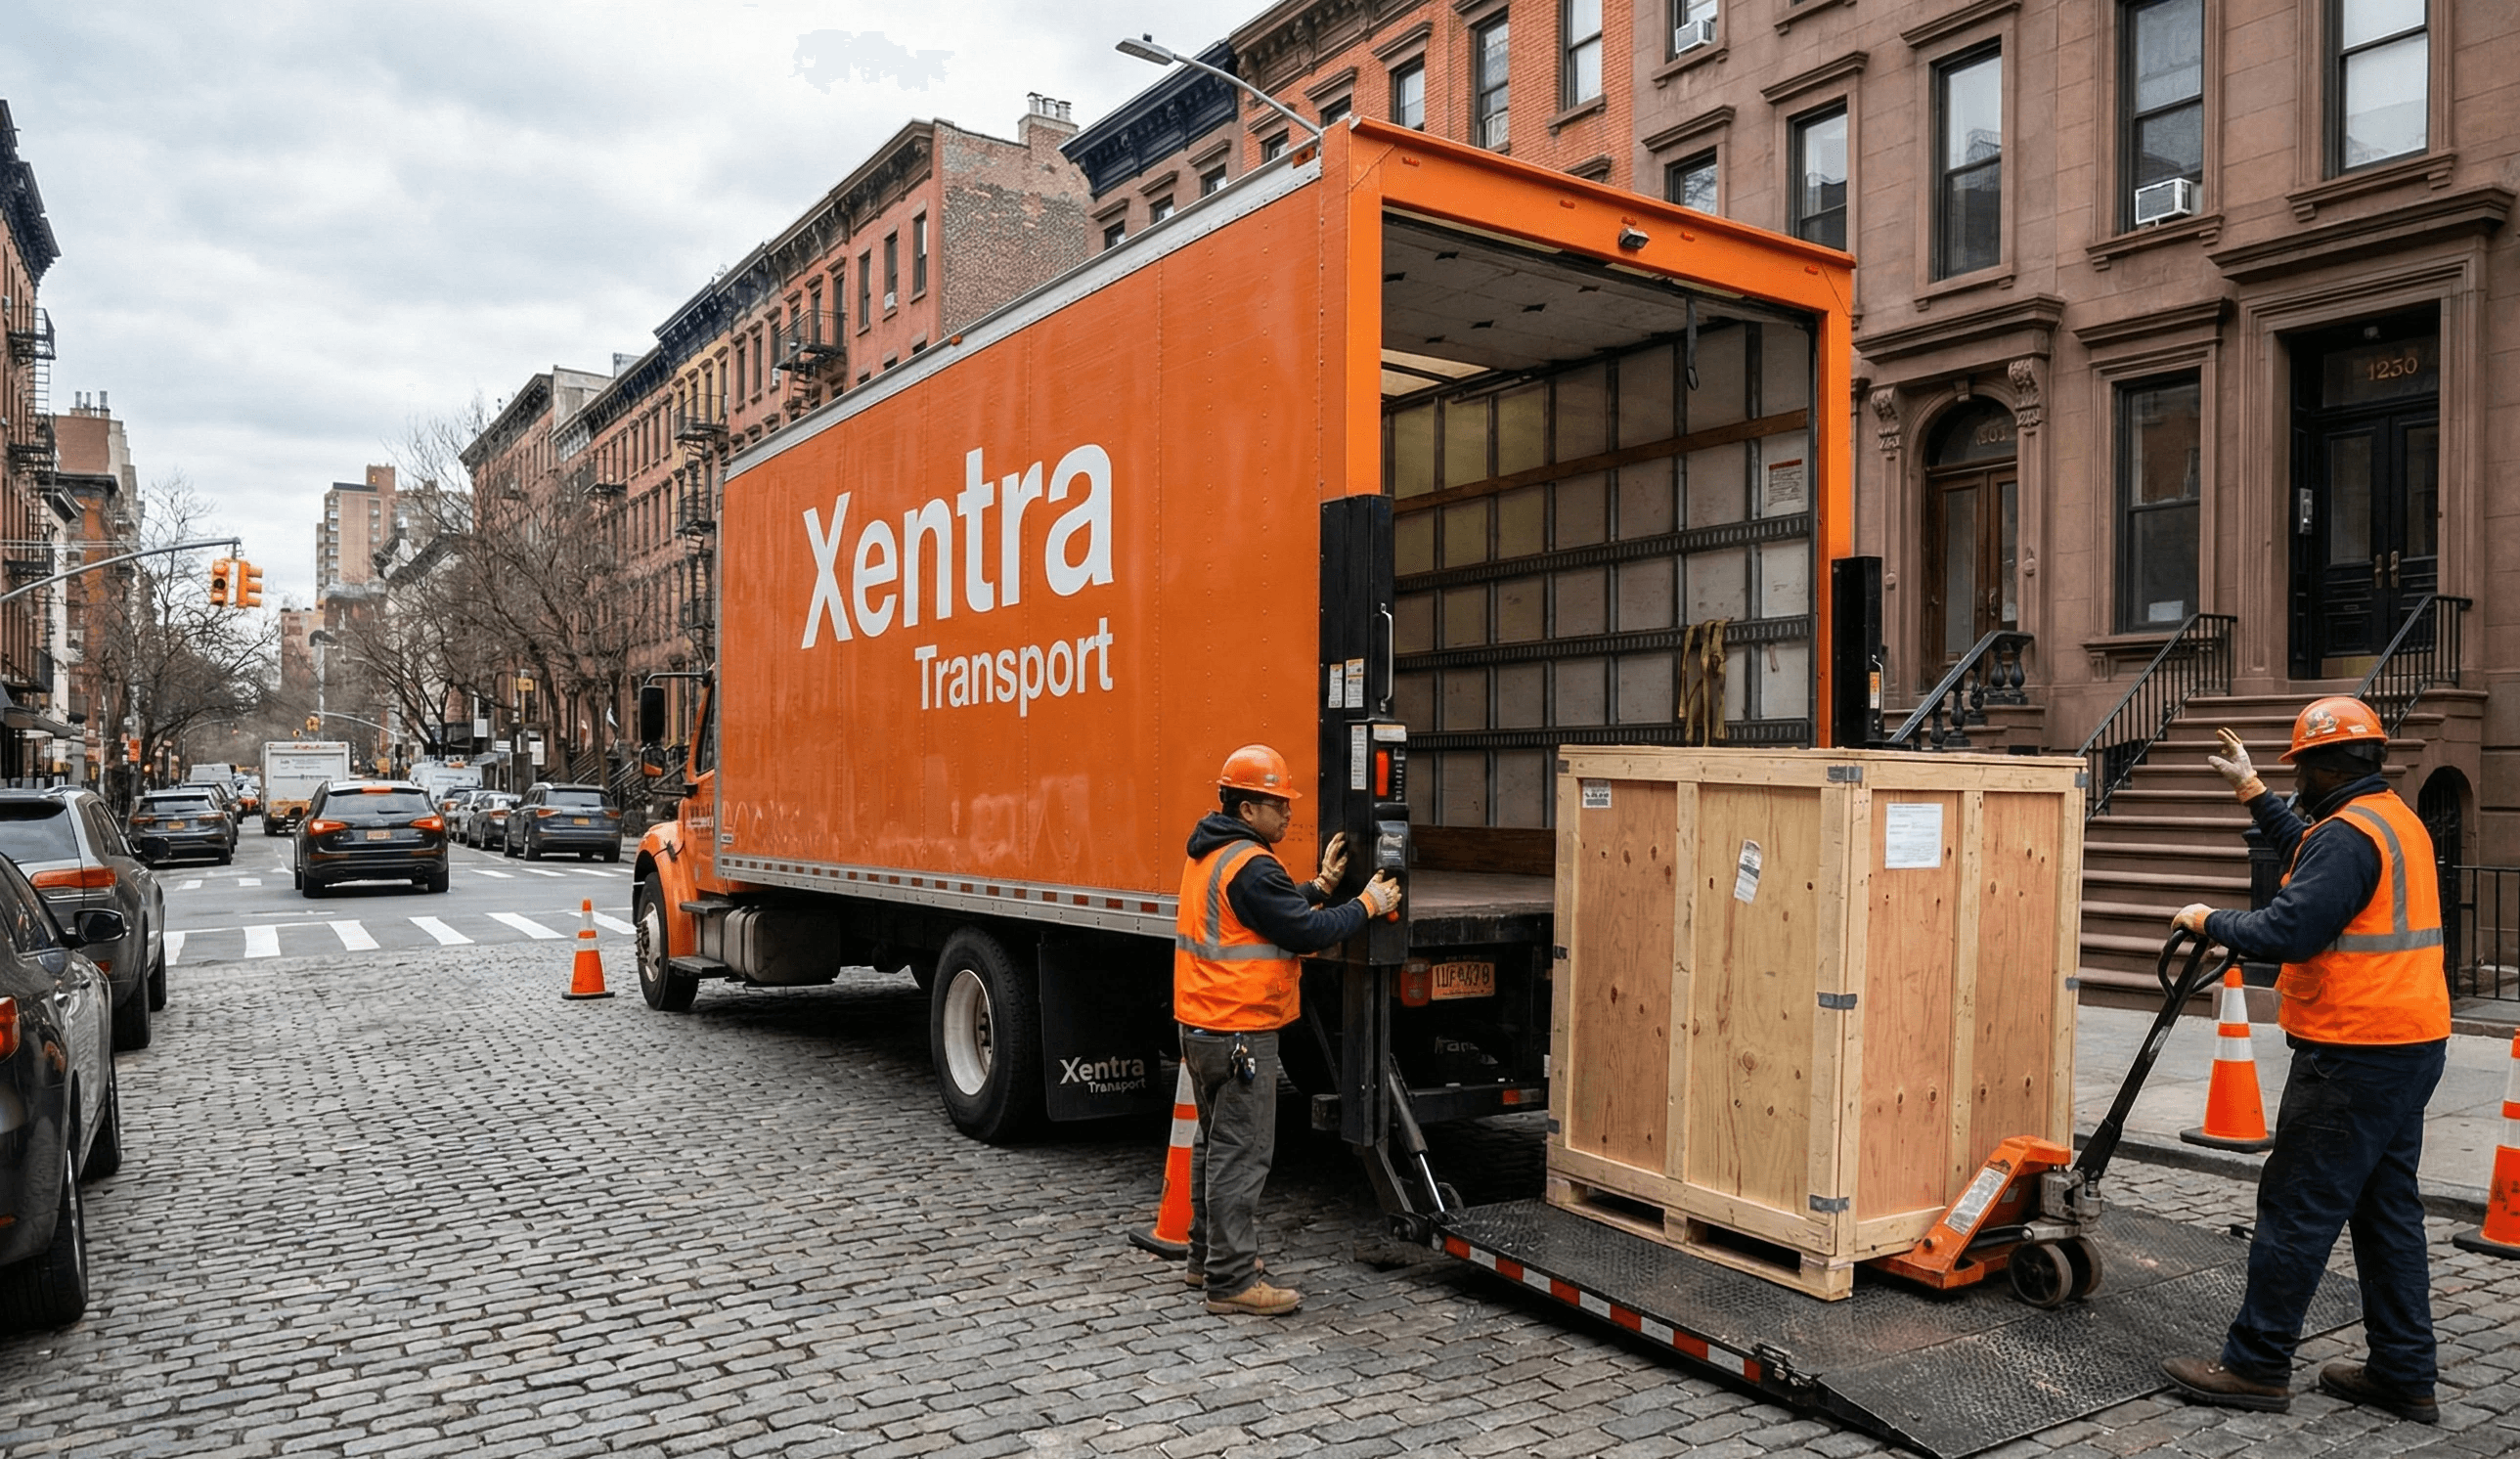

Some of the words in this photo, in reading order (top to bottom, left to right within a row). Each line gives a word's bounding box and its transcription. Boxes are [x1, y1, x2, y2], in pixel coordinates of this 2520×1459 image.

[801, 443, 1114, 649] Xentra
[915, 617, 1114, 718] Transport
[1059, 1056, 1145, 1084] Xentra
[1087, 1078, 1146, 1093] Transport
